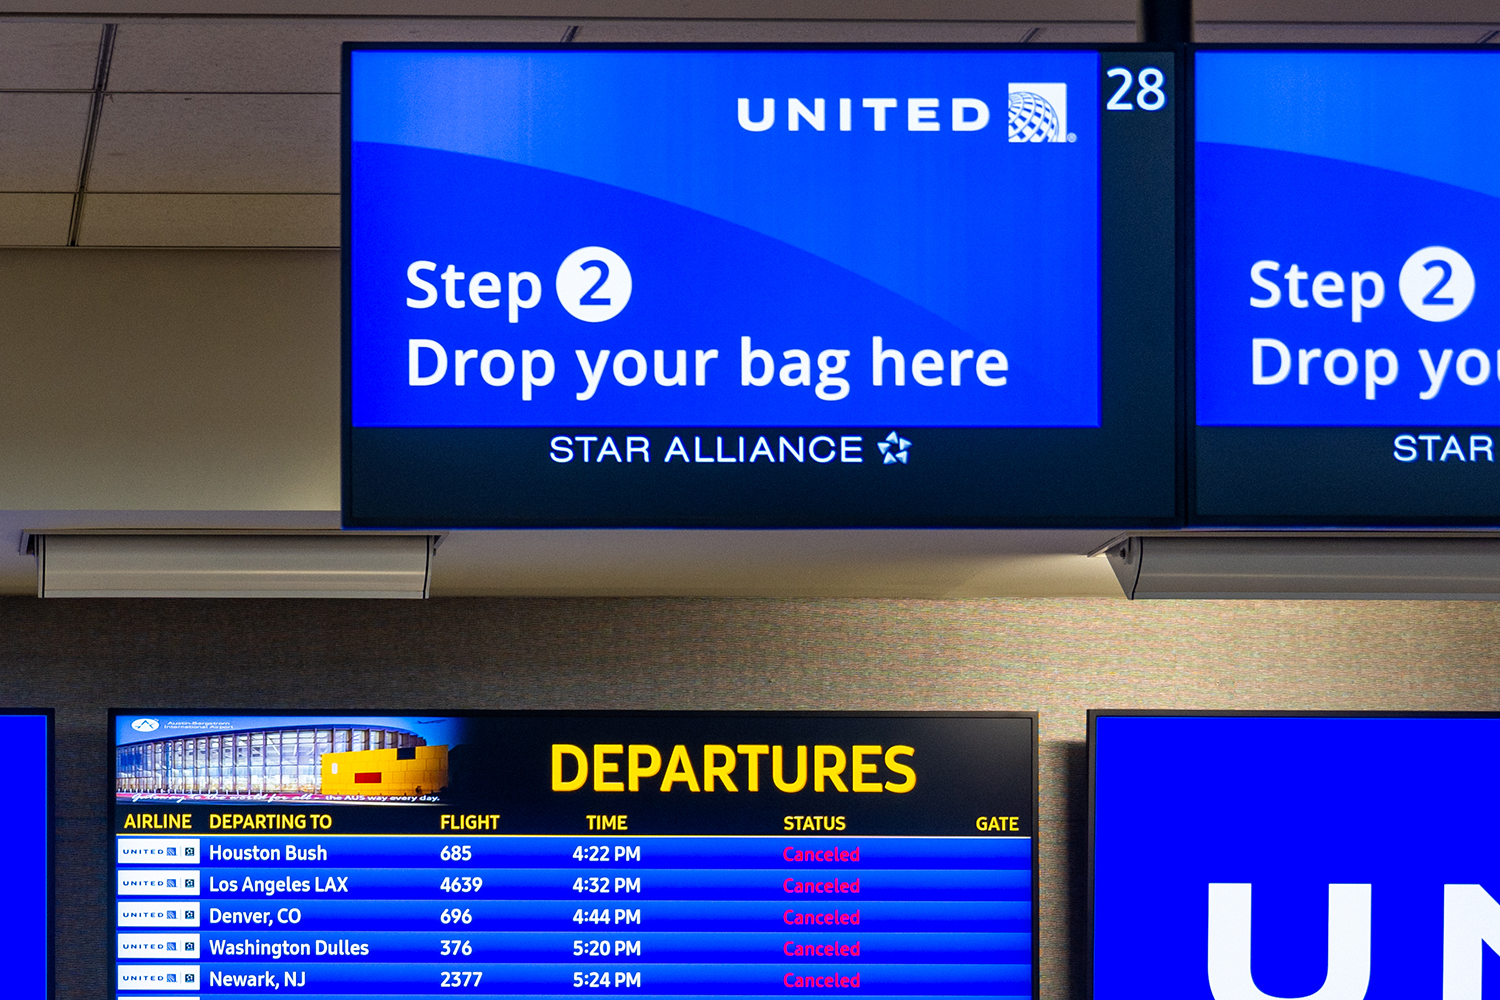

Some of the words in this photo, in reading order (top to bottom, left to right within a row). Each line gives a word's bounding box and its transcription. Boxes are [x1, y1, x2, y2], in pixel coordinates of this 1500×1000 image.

[1107, 69, 1164, 110] 28
[738, 98, 989, 131] UNITED
[406, 260, 543, 323] Step
[578, 260, 612, 306] 2
[1249, 260, 1385, 323] Step
[1420, 260, 1454, 306] 2
[409, 339, 555, 401] Drop
[575, 349, 718, 400] your
[741, 336, 850, 401] bag
[873, 336, 1008, 386] here
[1253, 338, 1398, 400] Drop
[1418, 349, 1500, 400] yo
[550, 437, 649, 462] STAR
[665, 437, 862, 462] ALLIANCE
[1394, 436, 1492, 461] STAR
[552, 744, 916, 793] DEPARTURES
[124, 814, 192, 829] AIRLINE
[210, 814, 306, 829] DEPARTING
[310, 814, 332, 829] TO
[441, 815, 500, 830] FLIGHT
[586, 815, 628, 830] TIME
[784, 816, 846, 830] STATUS
[976, 817, 1019, 831] GATE
[210, 845, 280, 860] Houston
[286, 845, 327, 860] Bush
[441, 846, 471, 860] 685
[573, 846, 609, 861] 4:22
[615, 846, 640, 861] PM
[783, 847, 859, 862] Canceled
[210, 877, 238, 891] Los
[242, 876, 310, 895] Angeles
[316, 877, 348, 892] LAX
[441, 877, 482, 892] 4639
[573, 877, 609, 892] 4:32
[615, 878, 640, 892] PM
[783, 878, 859, 893] Canceled
[210, 908, 273, 926] Denver,
[278, 908, 301, 923] CO
[441, 909, 472, 923] 696
[573, 909, 610, 924] 4:44
[615, 909, 640, 924] PM
[783, 909, 860, 925] Canceled
[210, 939, 310, 959] Washington
[316, 940, 369, 955] Dulles
[441, 940, 472, 955] 376
[574, 941, 610, 955] 5:20
[615, 941, 640, 955] PM
[783, 941, 860, 956] Canceled
[210, 971, 279, 989] Newark,
[285, 972, 305, 986] NJ
[441, 972, 482, 987] 2377
[574, 972, 610, 987] 5:24
[615, 972, 640, 987] PM
[784, 972, 860, 987] Canceled
